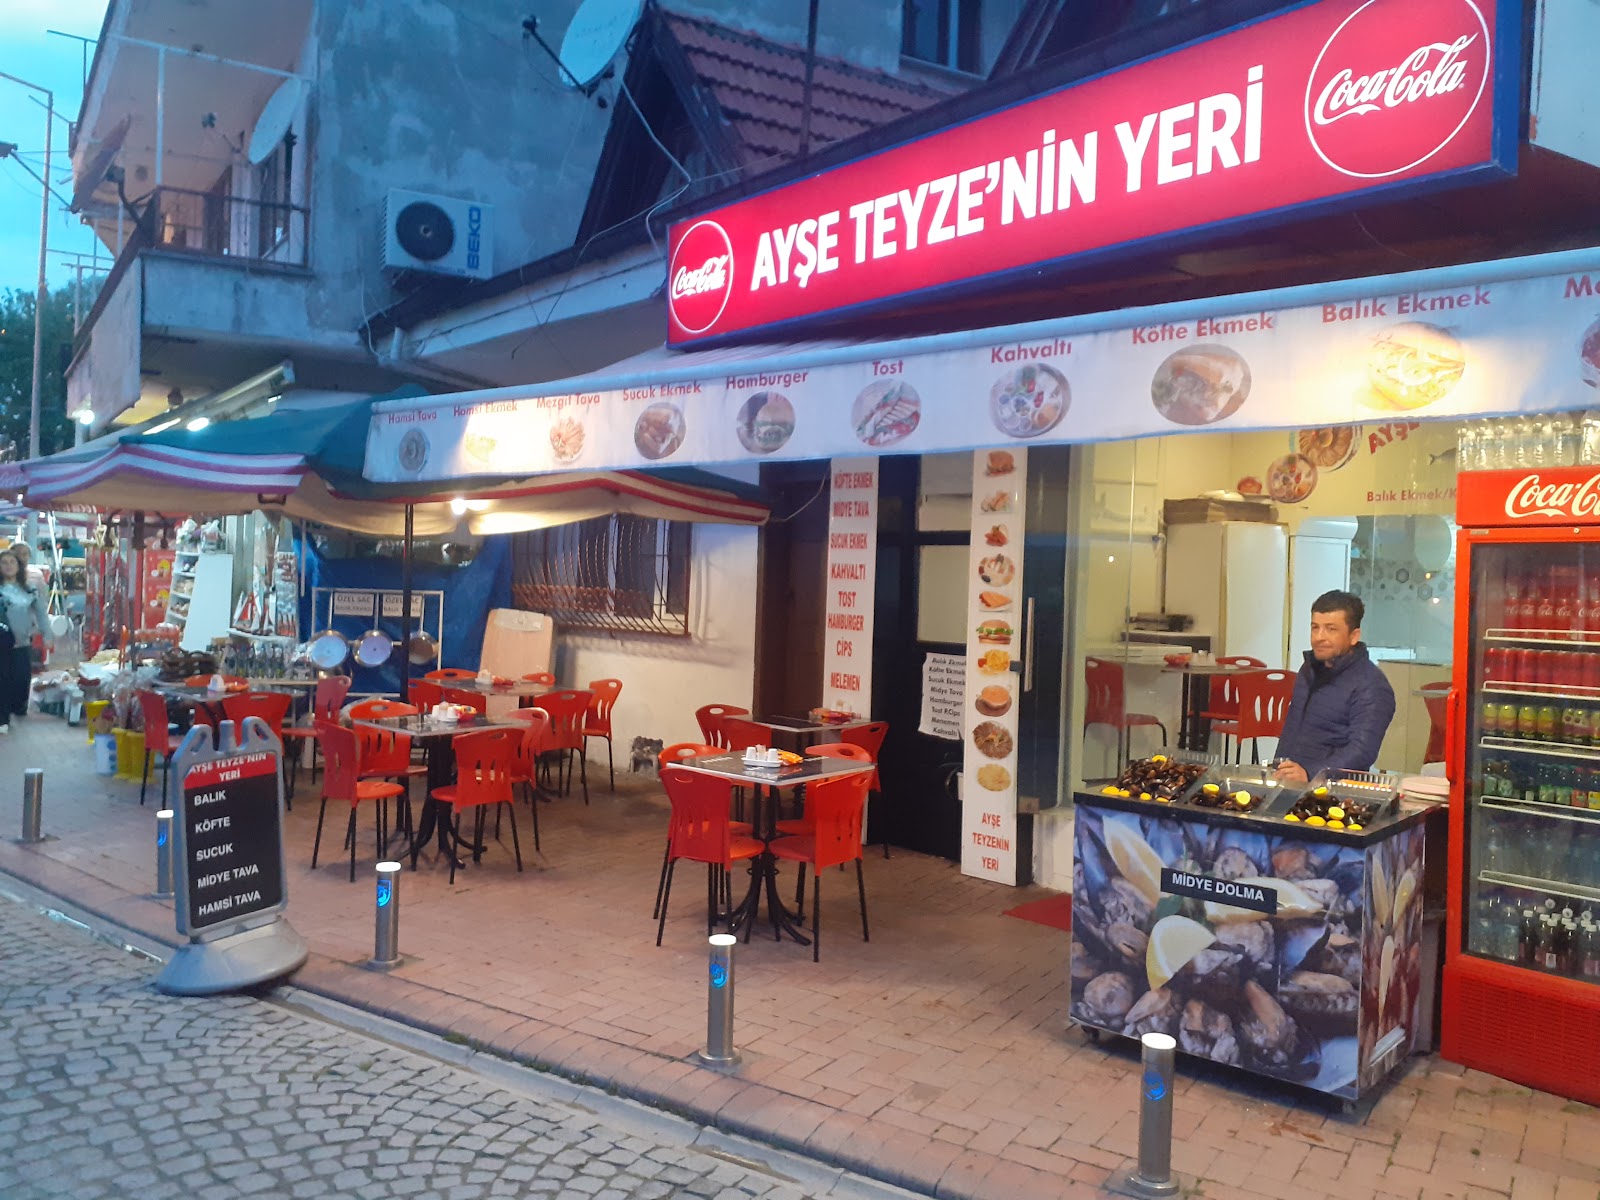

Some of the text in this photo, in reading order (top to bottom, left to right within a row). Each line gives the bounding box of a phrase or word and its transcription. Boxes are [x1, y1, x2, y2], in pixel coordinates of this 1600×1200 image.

[1314, 32, 1478, 125] Coca-Cola
[750, 64, 1264, 288] AYŞE TEYZE'NİN YERİ
[467, 206, 480, 269] BEKO
[672, 254, 729, 300] Coca-Cola
[1322, 286, 1491, 324] Balık Ekmek
[1132, 312, 1274, 345] Köfte Ekmek
[990, 340, 1072, 364] Kahvaltı
[872, 360, 904, 376] Tost
[725, 371, 808, 390] Hamburger
[623, 380, 702, 400] Sucuk Ekmek
[454, 400, 518, 416] Hamsi Ekmek
[537, 393, 600, 410] Mezgit Tava
[388, 410, 437, 424] Hamsi Tava
[853, 472, 874, 489] EKMEK
[1367, 490, 1397, 502] Balık
[854, 501, 869, 517] TAVA
[831, 533, 868, 549] SUCUK EKMEK
[831, 563, 866, 580] KAHVALTI
[838, 591, 856, 607] TOST
[828, 613, 864, 631] HAMBURGER
[946, 667, 966, 675] Ekmek
[831, 672, 860, 691] MELEMEN
[930, 686, 963, 696] Midye Tava
[930, 696, 963, 707] Hamburger
[931, 717, 960, 727] Menemen
[219, 769, 241, 782] YERİ
[194, 790, 226, 806] BALIK
[195, 816, 231, 834] KÖFTE
[982, 812, 1001, 829] AYŞE
[972, 832, 1010, 851] TEYZENİN
[196, 843, 233, 861] SUCUK
[982, 856, 999, 871] YERİ
[197, 864, 259, 888] MİDYE TAVA
[1172, 871, 1264, 902] MİDYE DOLMA
[198, 890, 261, 915] HAMSİ TAVA
